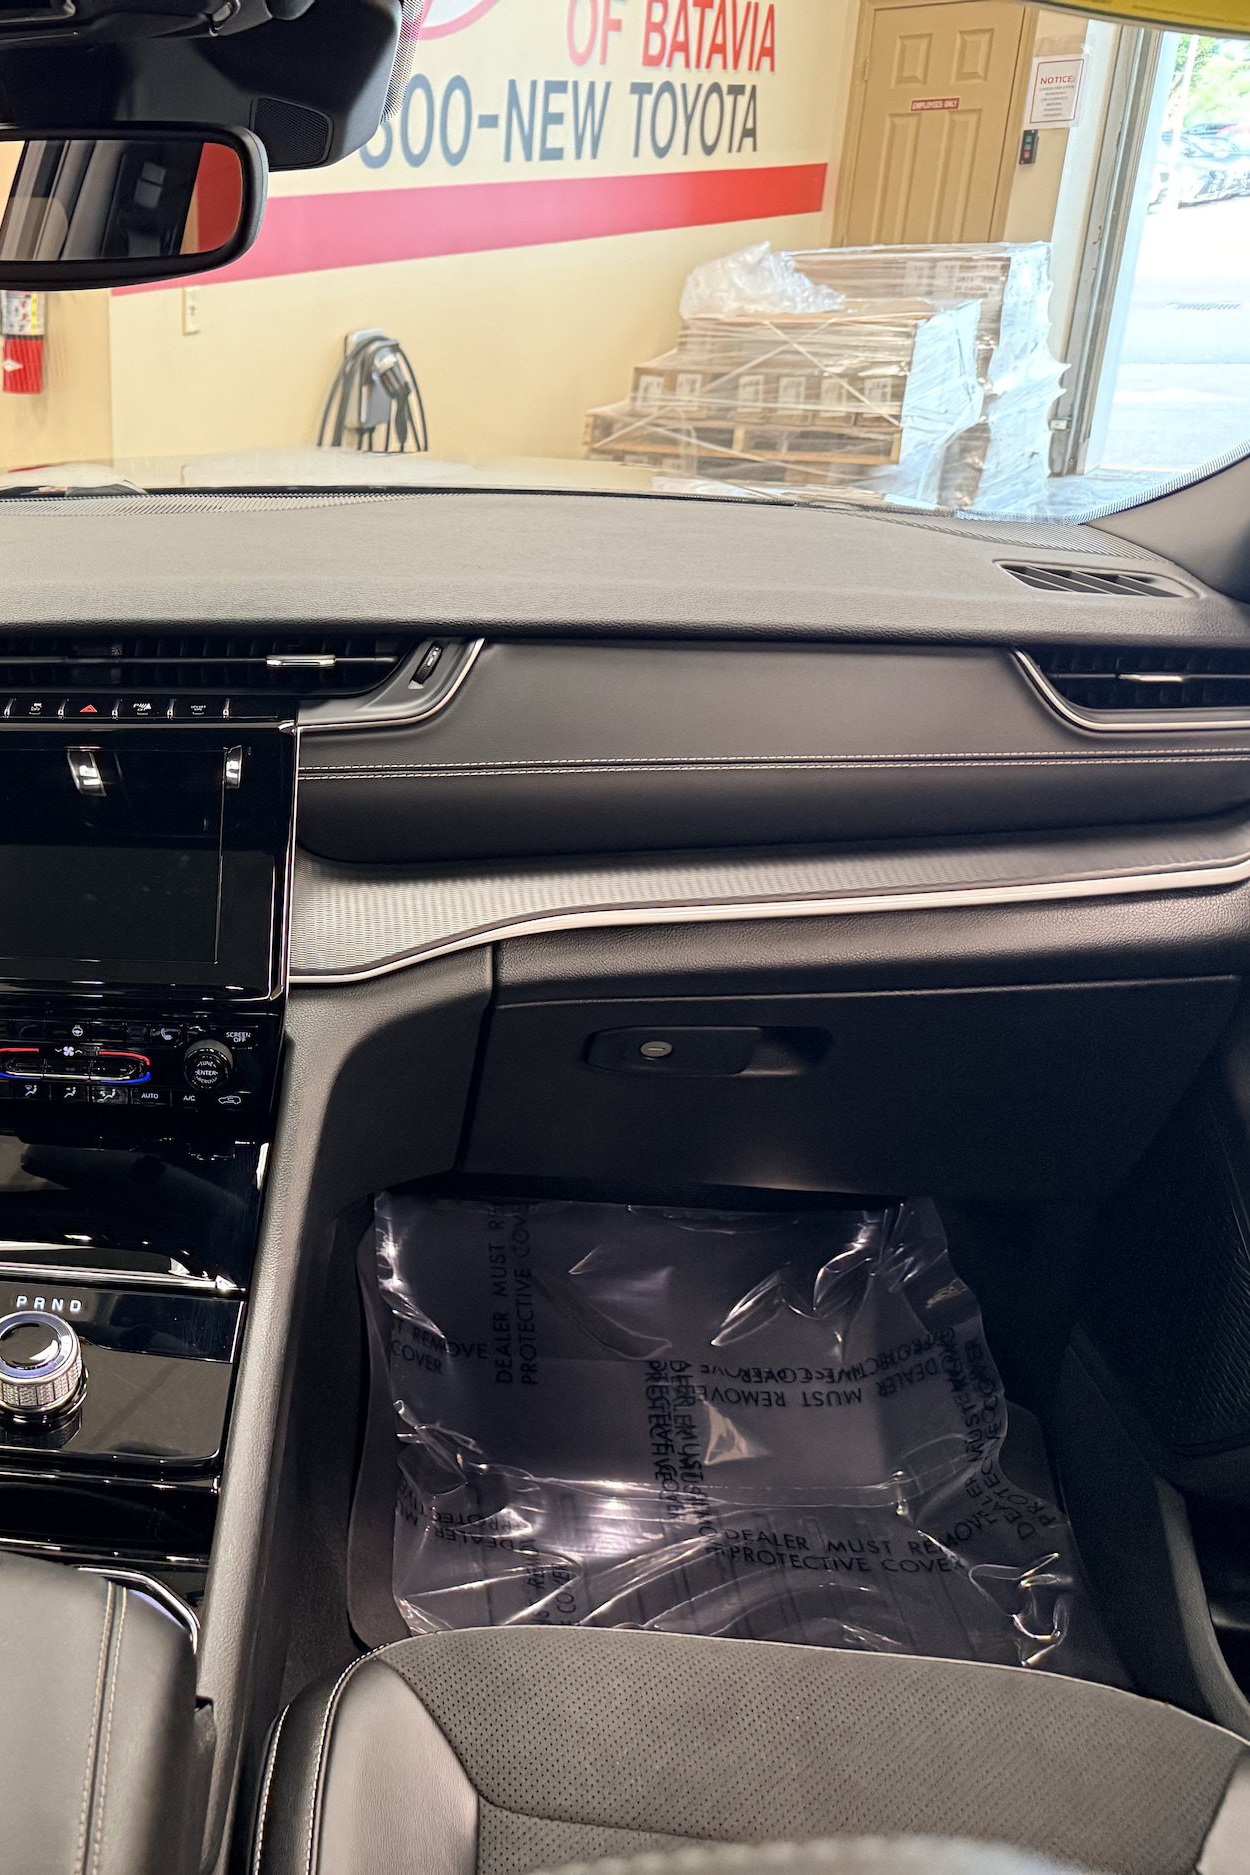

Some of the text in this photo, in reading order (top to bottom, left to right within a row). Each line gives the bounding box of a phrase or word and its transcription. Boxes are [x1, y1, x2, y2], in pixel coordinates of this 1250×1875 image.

[566, 0, 776, 73] OF BATAVIA
[629, 81, 759, 159] TOYOTA
[489, 1243, 509, 1298] MUST
[493, 1311, 514, 1385] DEALER
[514, 1268, 539, 1386] PROTECTIVE
[803, 1388, 863, 1408] MUST
[724, 1528, 810, 1551] DEALER
[828, 1538, 900, 1556] MUST
[879, 1556, 956, 1573] COVE
